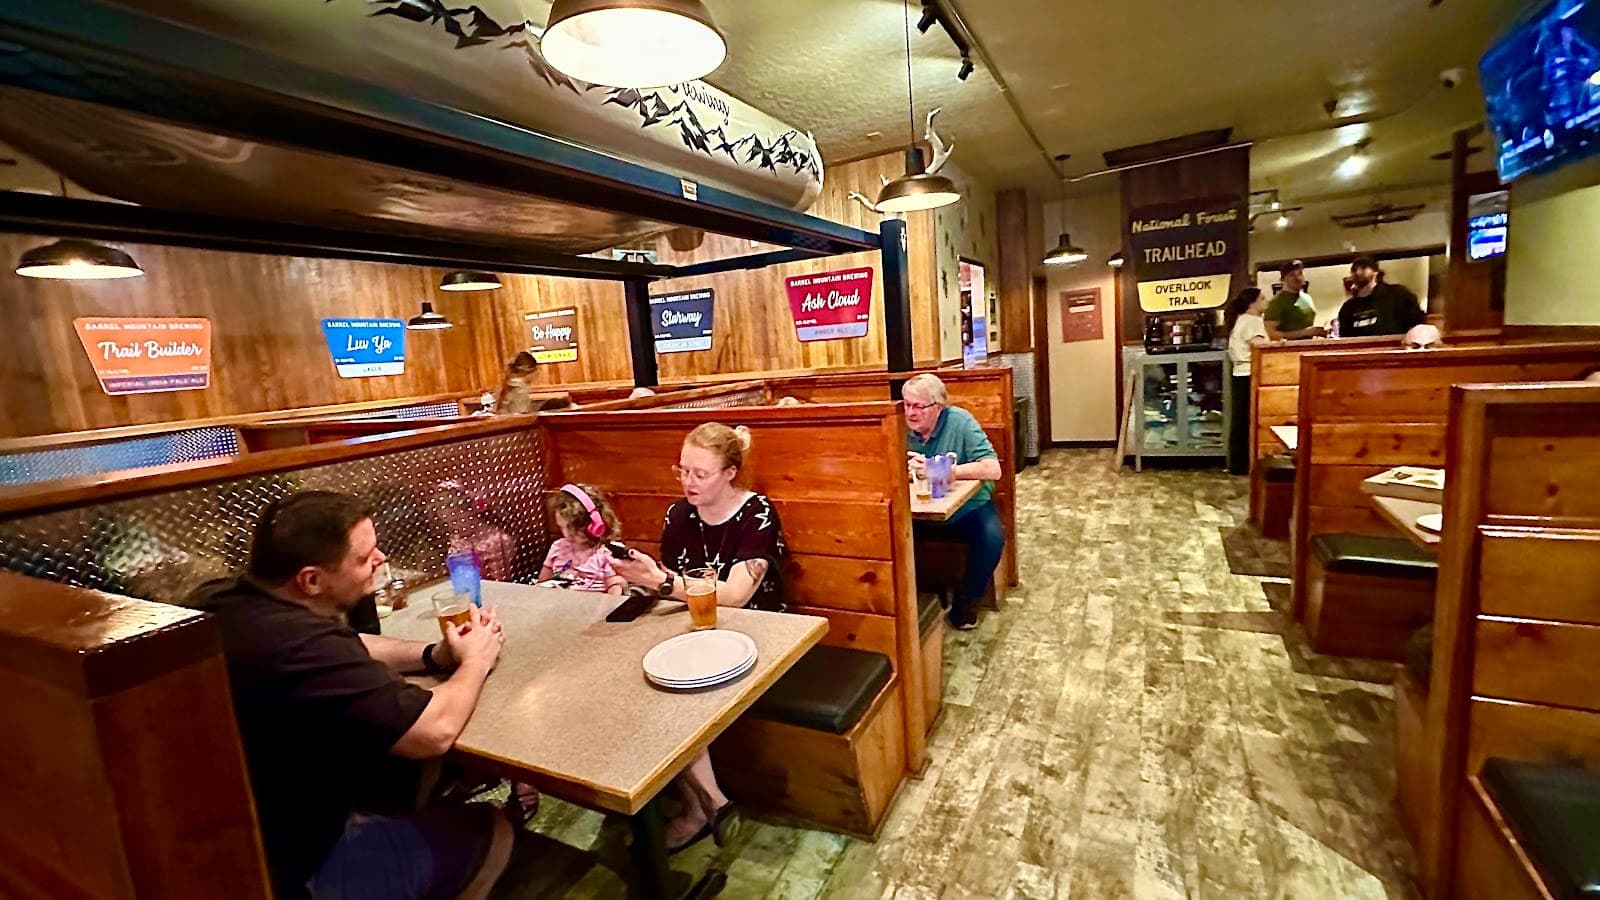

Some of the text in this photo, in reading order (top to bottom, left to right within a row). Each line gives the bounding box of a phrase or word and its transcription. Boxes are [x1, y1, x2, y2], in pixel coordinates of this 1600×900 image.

[1132, 209, 1238, 234] National Forest
[1143, 240, 1227, 264] TRAILHEAD
[790, 279, 811, 287] BARREL
[812, 275, 841, 284] MOUNTAIN
[1155, 280, 1212, 295] OVERLOOK
[801, 288, 861, 312] Ash Cloud
[1169, 296, 1199, 307] TRAIL
[85, 323, 121, 331] BARREL
[531, 323, 572, 342] Be Happy
[97, 339, 203, 361] Trail Builder
[346, 334, 393, 355] Luv Ya
